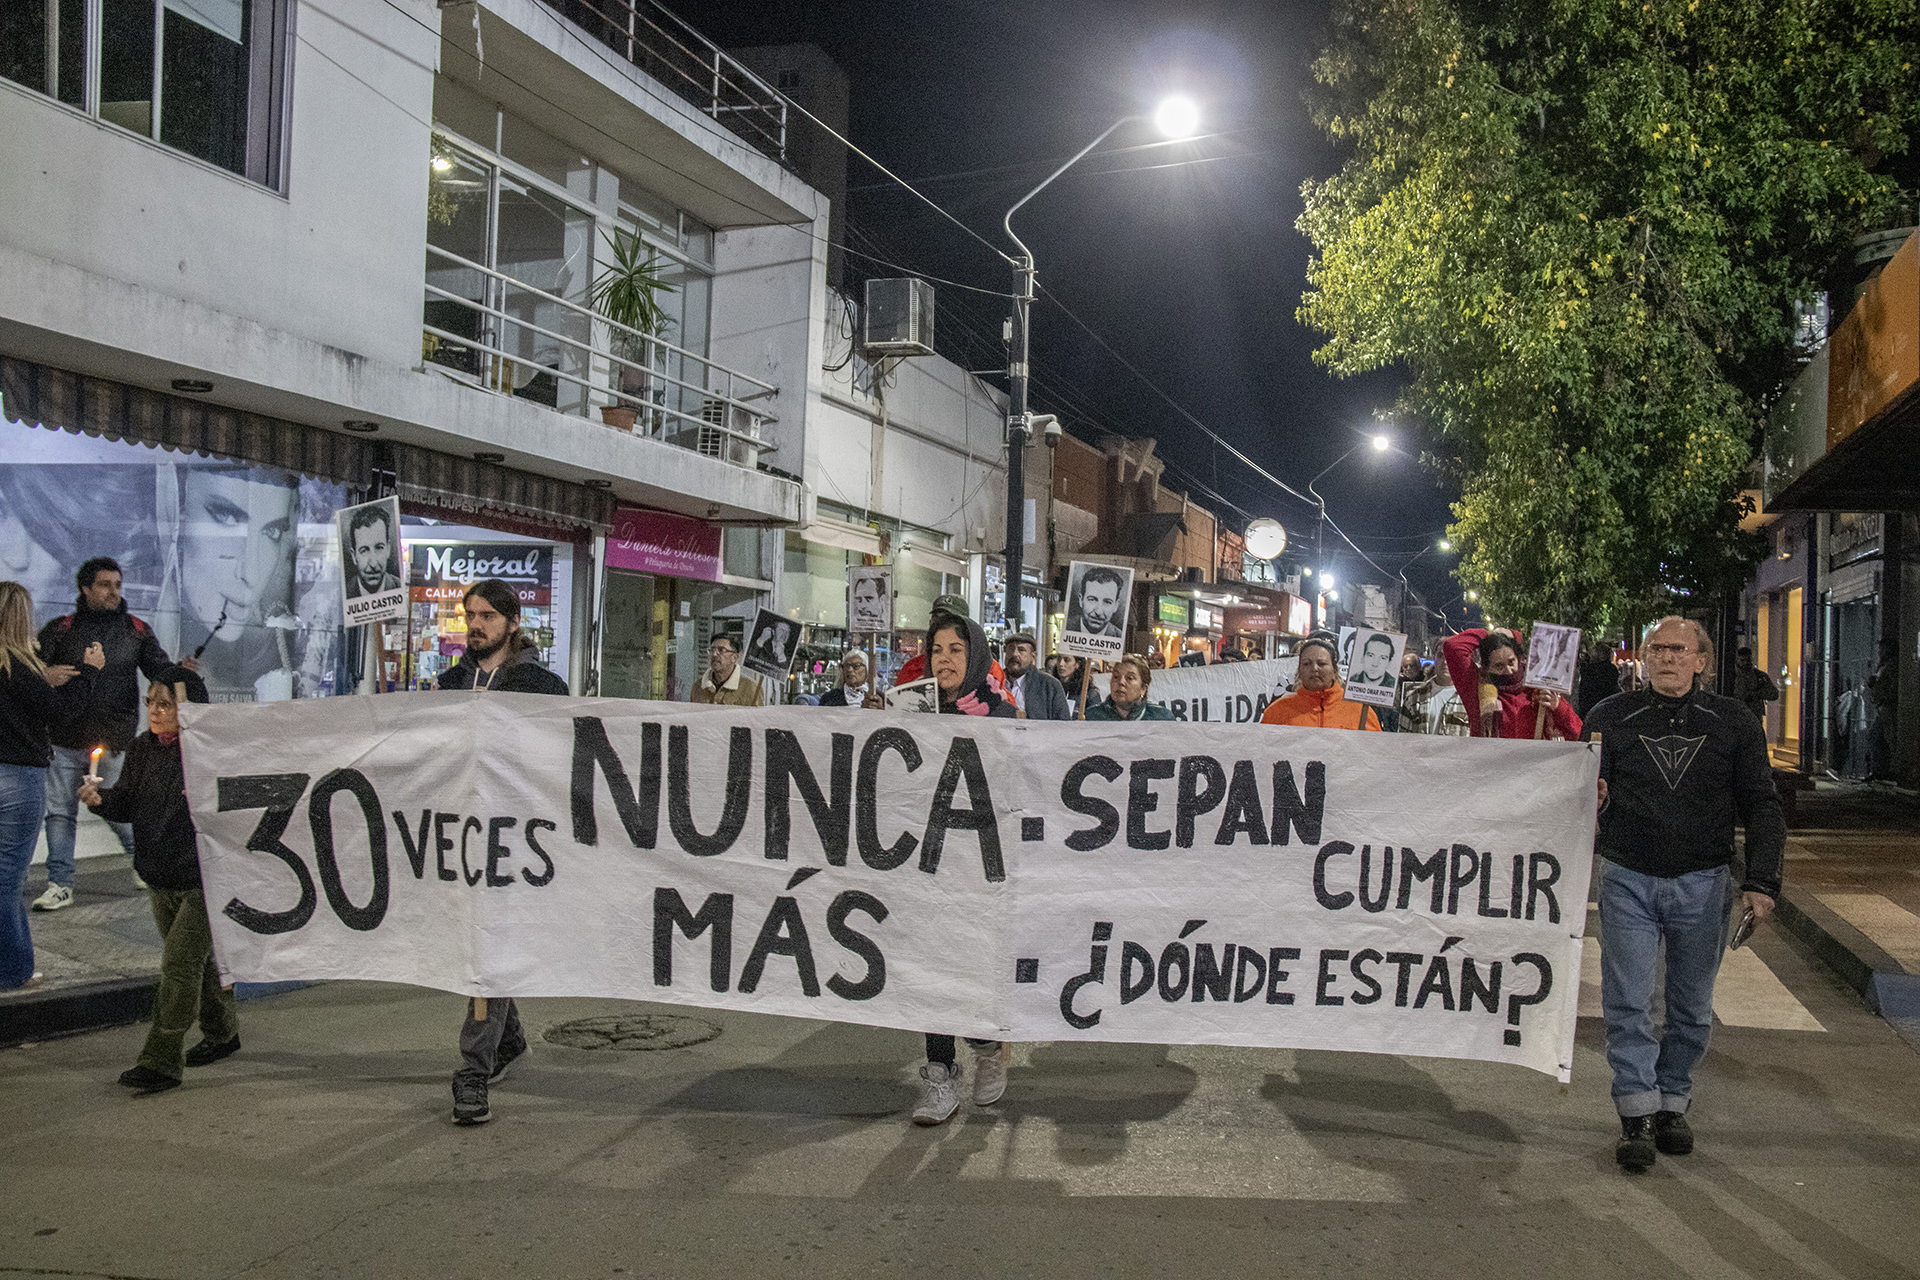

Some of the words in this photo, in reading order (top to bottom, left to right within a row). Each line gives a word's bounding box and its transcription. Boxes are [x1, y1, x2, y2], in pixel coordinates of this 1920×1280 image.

[424, 547, 539, 585] Mejoral
[425, 588, 464, 599] CALMA
[346, 601, 370, 615] JULIO
[371, 594, 404, 610] CASTRO
[1063, 635, 1087, 645] JULIO
[1089, 638, 1121, 650] CASTRO
[1347, 685, 1367, 694] ANTONIO
[217, 768, 389, 934] 30
[392, 809, 556, 887] VECES
[571, 716, 1005, 882] NUNCA
[1060, 755, 1325, 851] SEPAN
[1313, 840, 1561, 924] CUMPLIR
[653, 867, 889, 1001] MÁS
[1059, 920, 1301, 1029] ¿DÓNDE
[1315, 936, 1553, 1046] ESTÁN?
